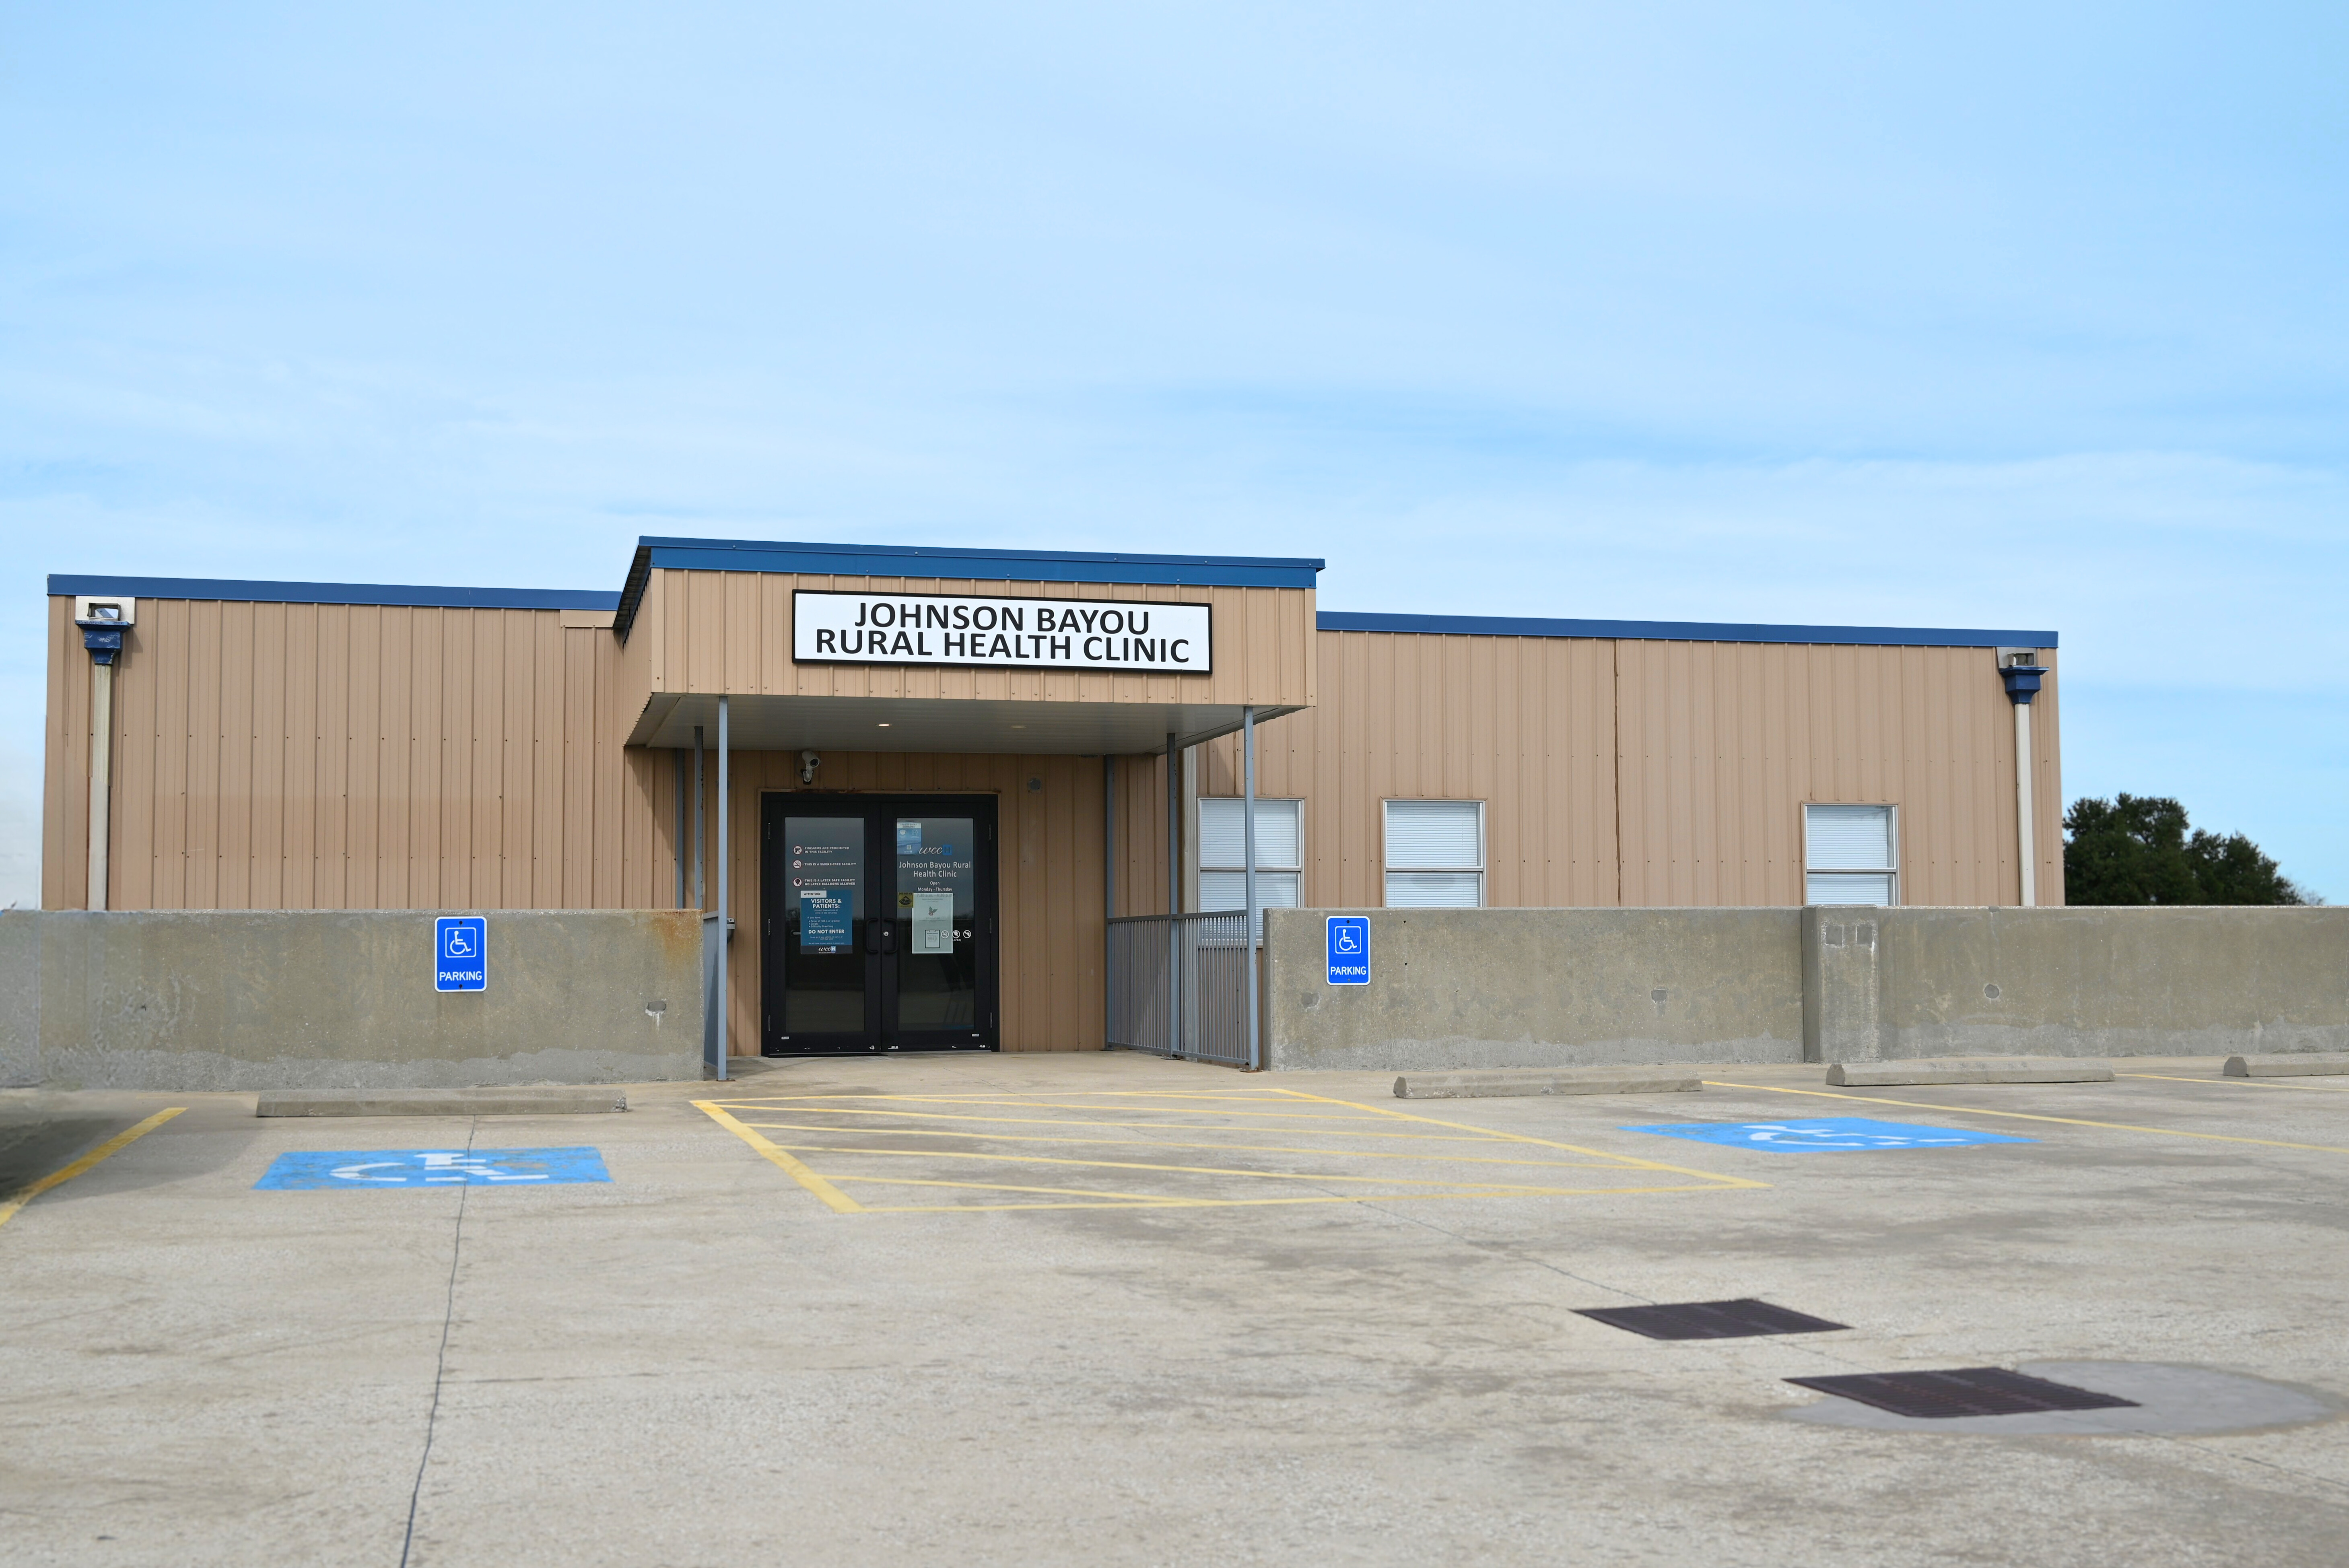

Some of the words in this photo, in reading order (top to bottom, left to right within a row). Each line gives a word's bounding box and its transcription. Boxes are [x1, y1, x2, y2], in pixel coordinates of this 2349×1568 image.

[855, 603, 1023, 631] JOHNSON
[1037, 608, 1149, 635] BAYOU
[817, 629, 932, 656] RURAL
[944, 633, 1070, 659] HEALTH
[1084, 637, 1189, 663] CLINIC
[929, 861, 951, 870] Bayou
[1330, 966, 1366, 975] PARKING
[439, 971, 482, 981] PARKING
